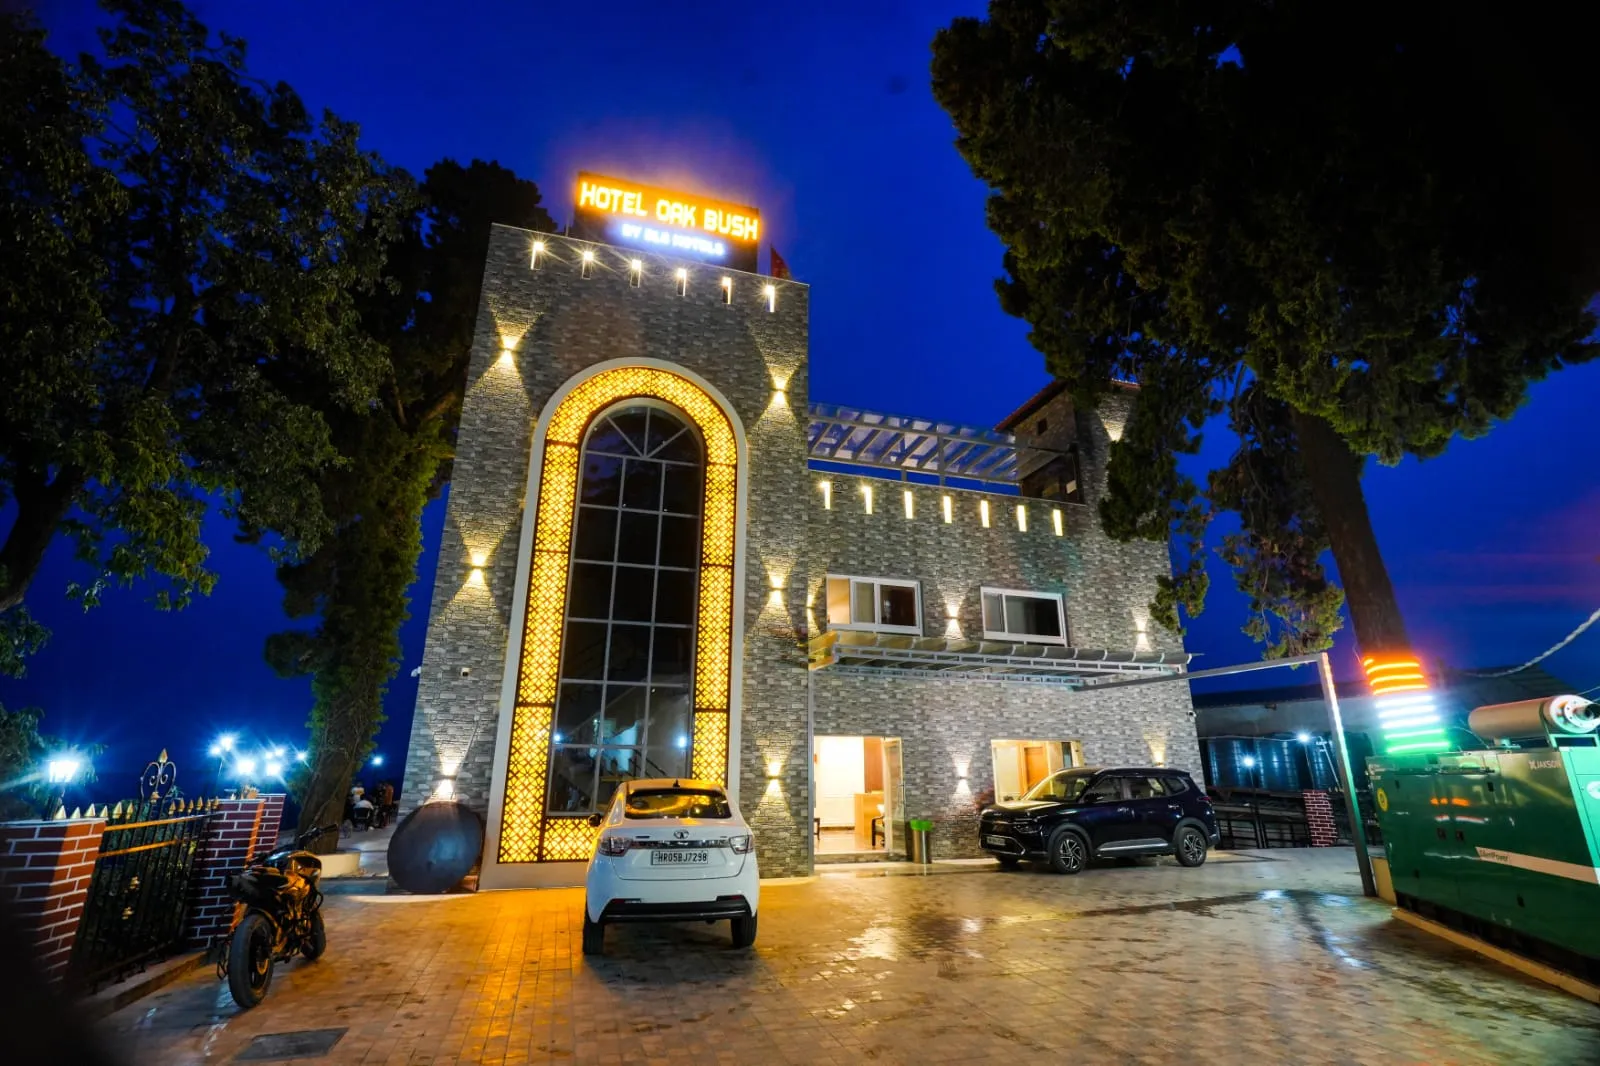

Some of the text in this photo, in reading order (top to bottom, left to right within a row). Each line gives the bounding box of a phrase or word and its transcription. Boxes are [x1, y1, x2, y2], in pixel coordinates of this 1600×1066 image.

[579, 181, 758, 240] HOTEL OAK BUSH
